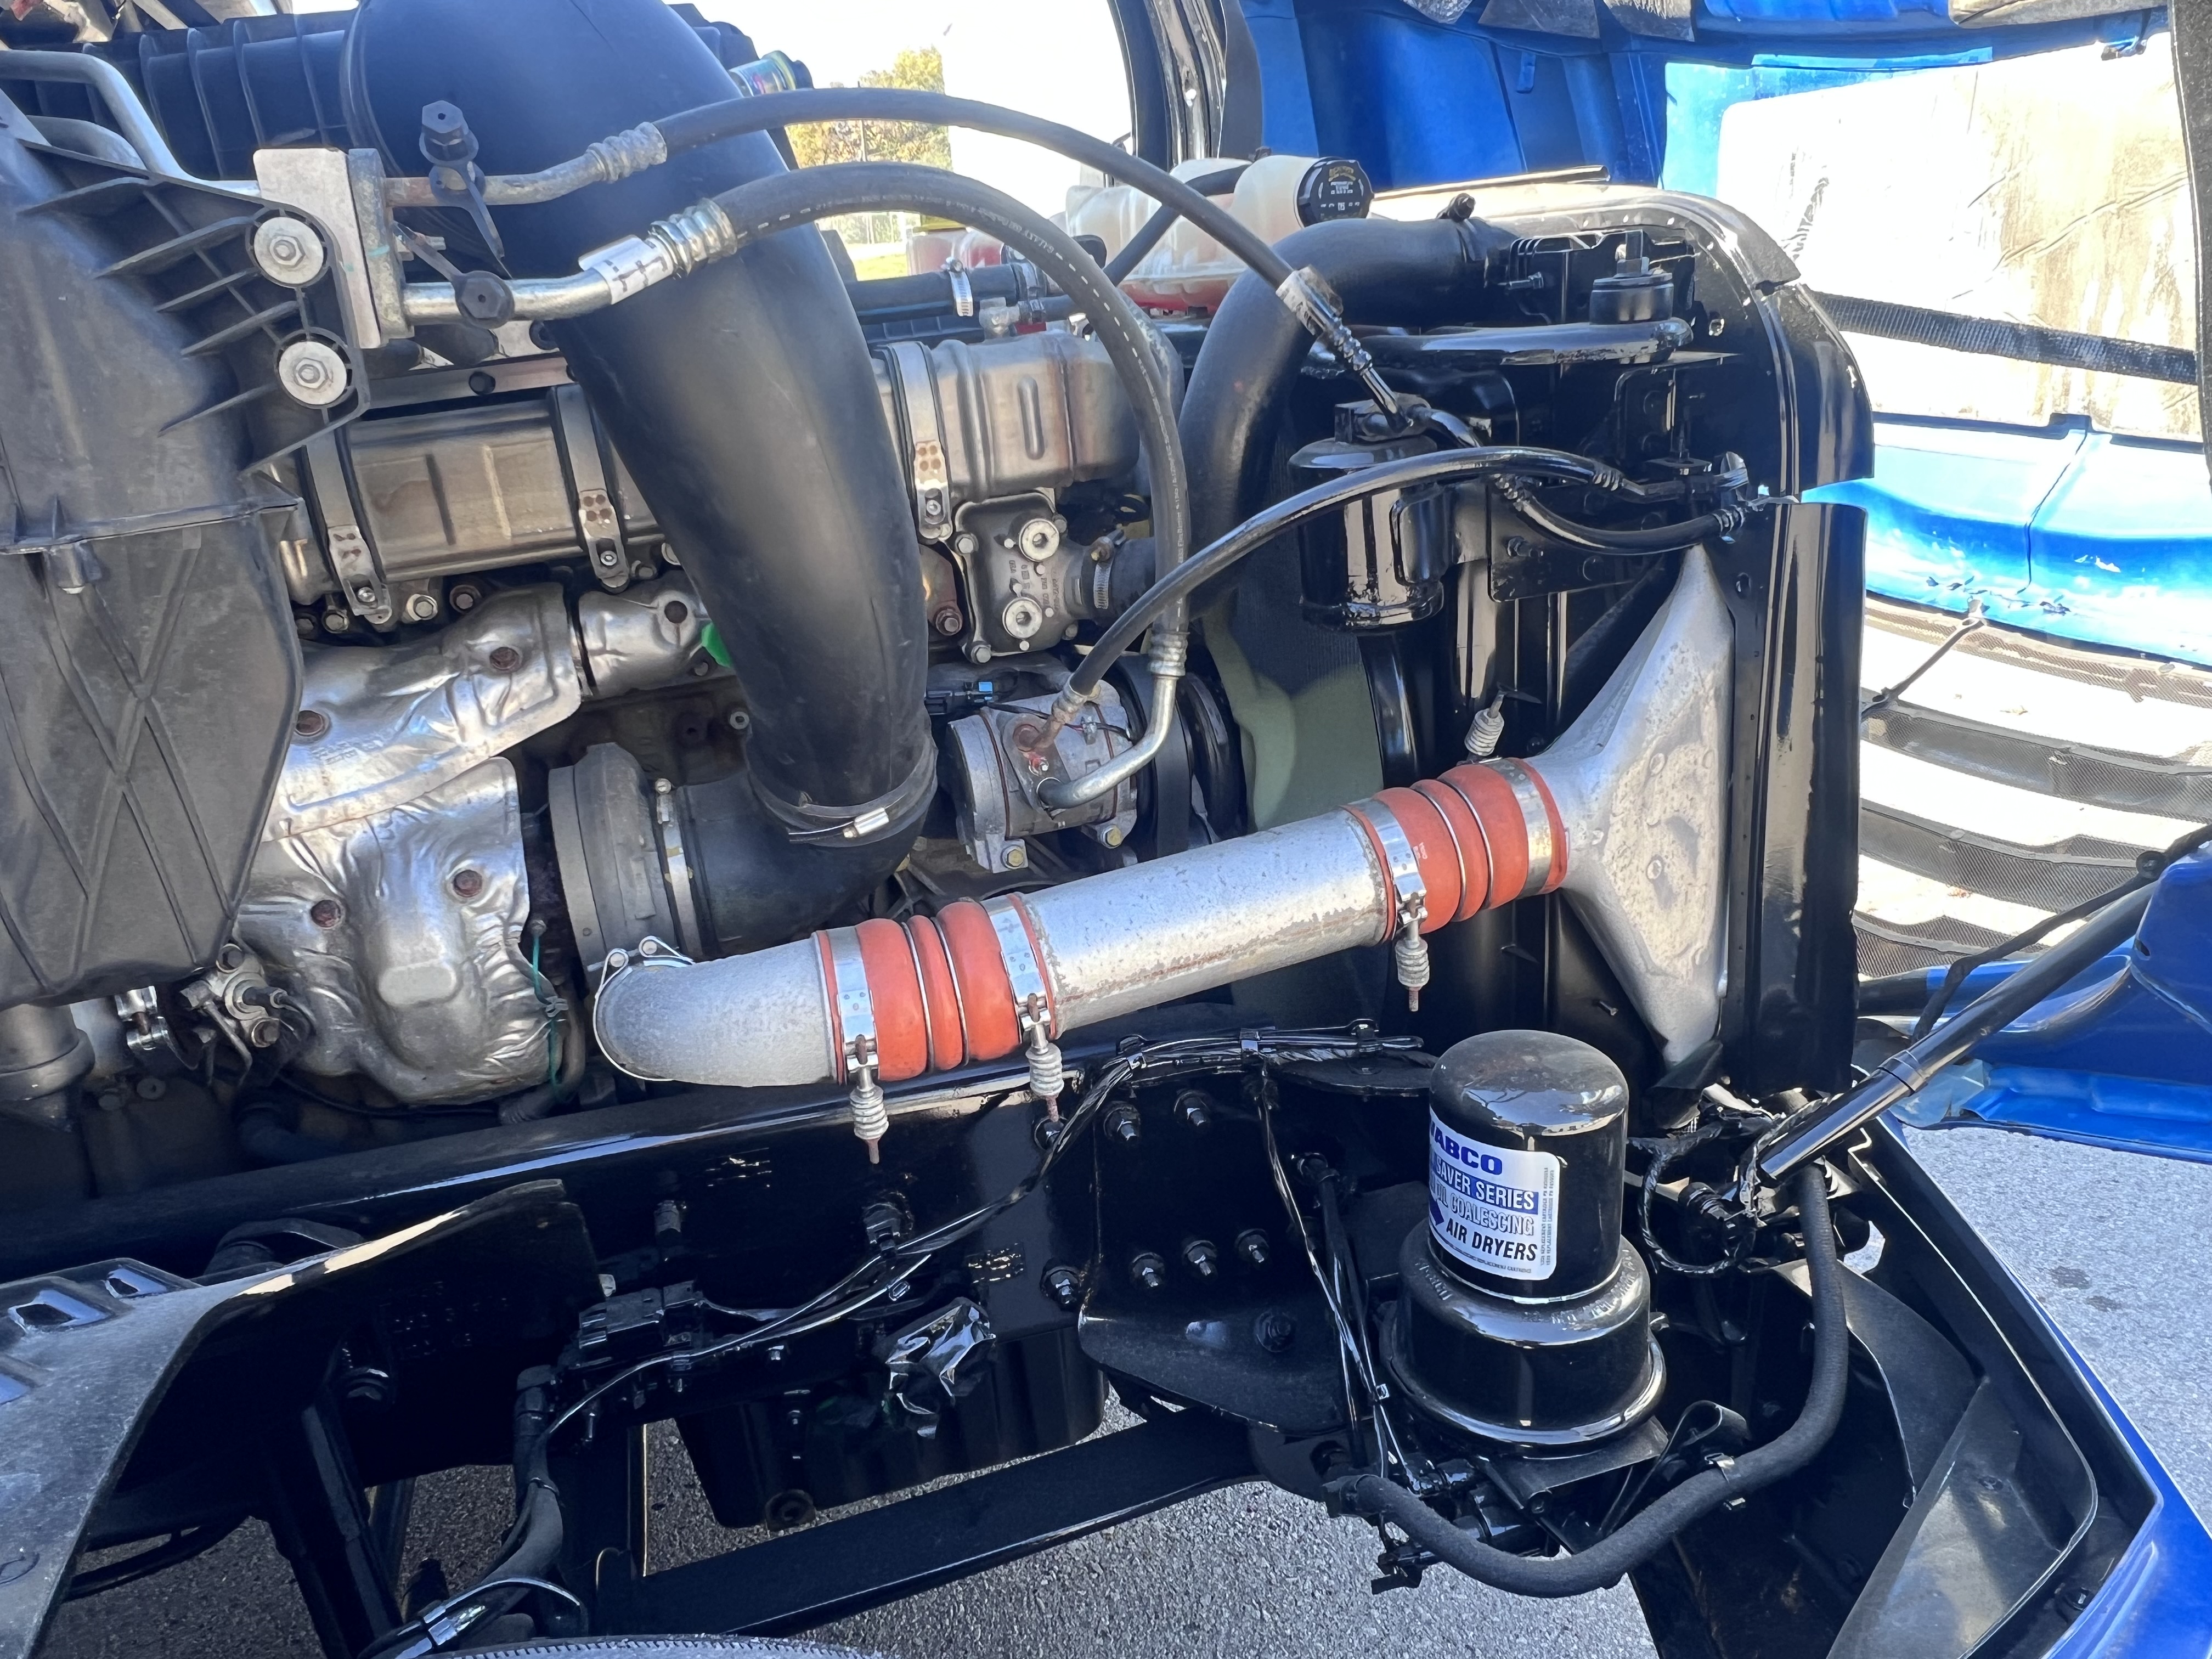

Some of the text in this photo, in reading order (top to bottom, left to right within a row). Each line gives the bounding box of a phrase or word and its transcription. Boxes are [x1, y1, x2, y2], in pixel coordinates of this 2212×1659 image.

[1436, 1156, 1471, 1196] SAVER
[1476, 1181, 1534, 1210] SERIES
[1446, 1217, 1468, 1244] AIR
[1472, 1231, 1538, 1261] DRYERS
